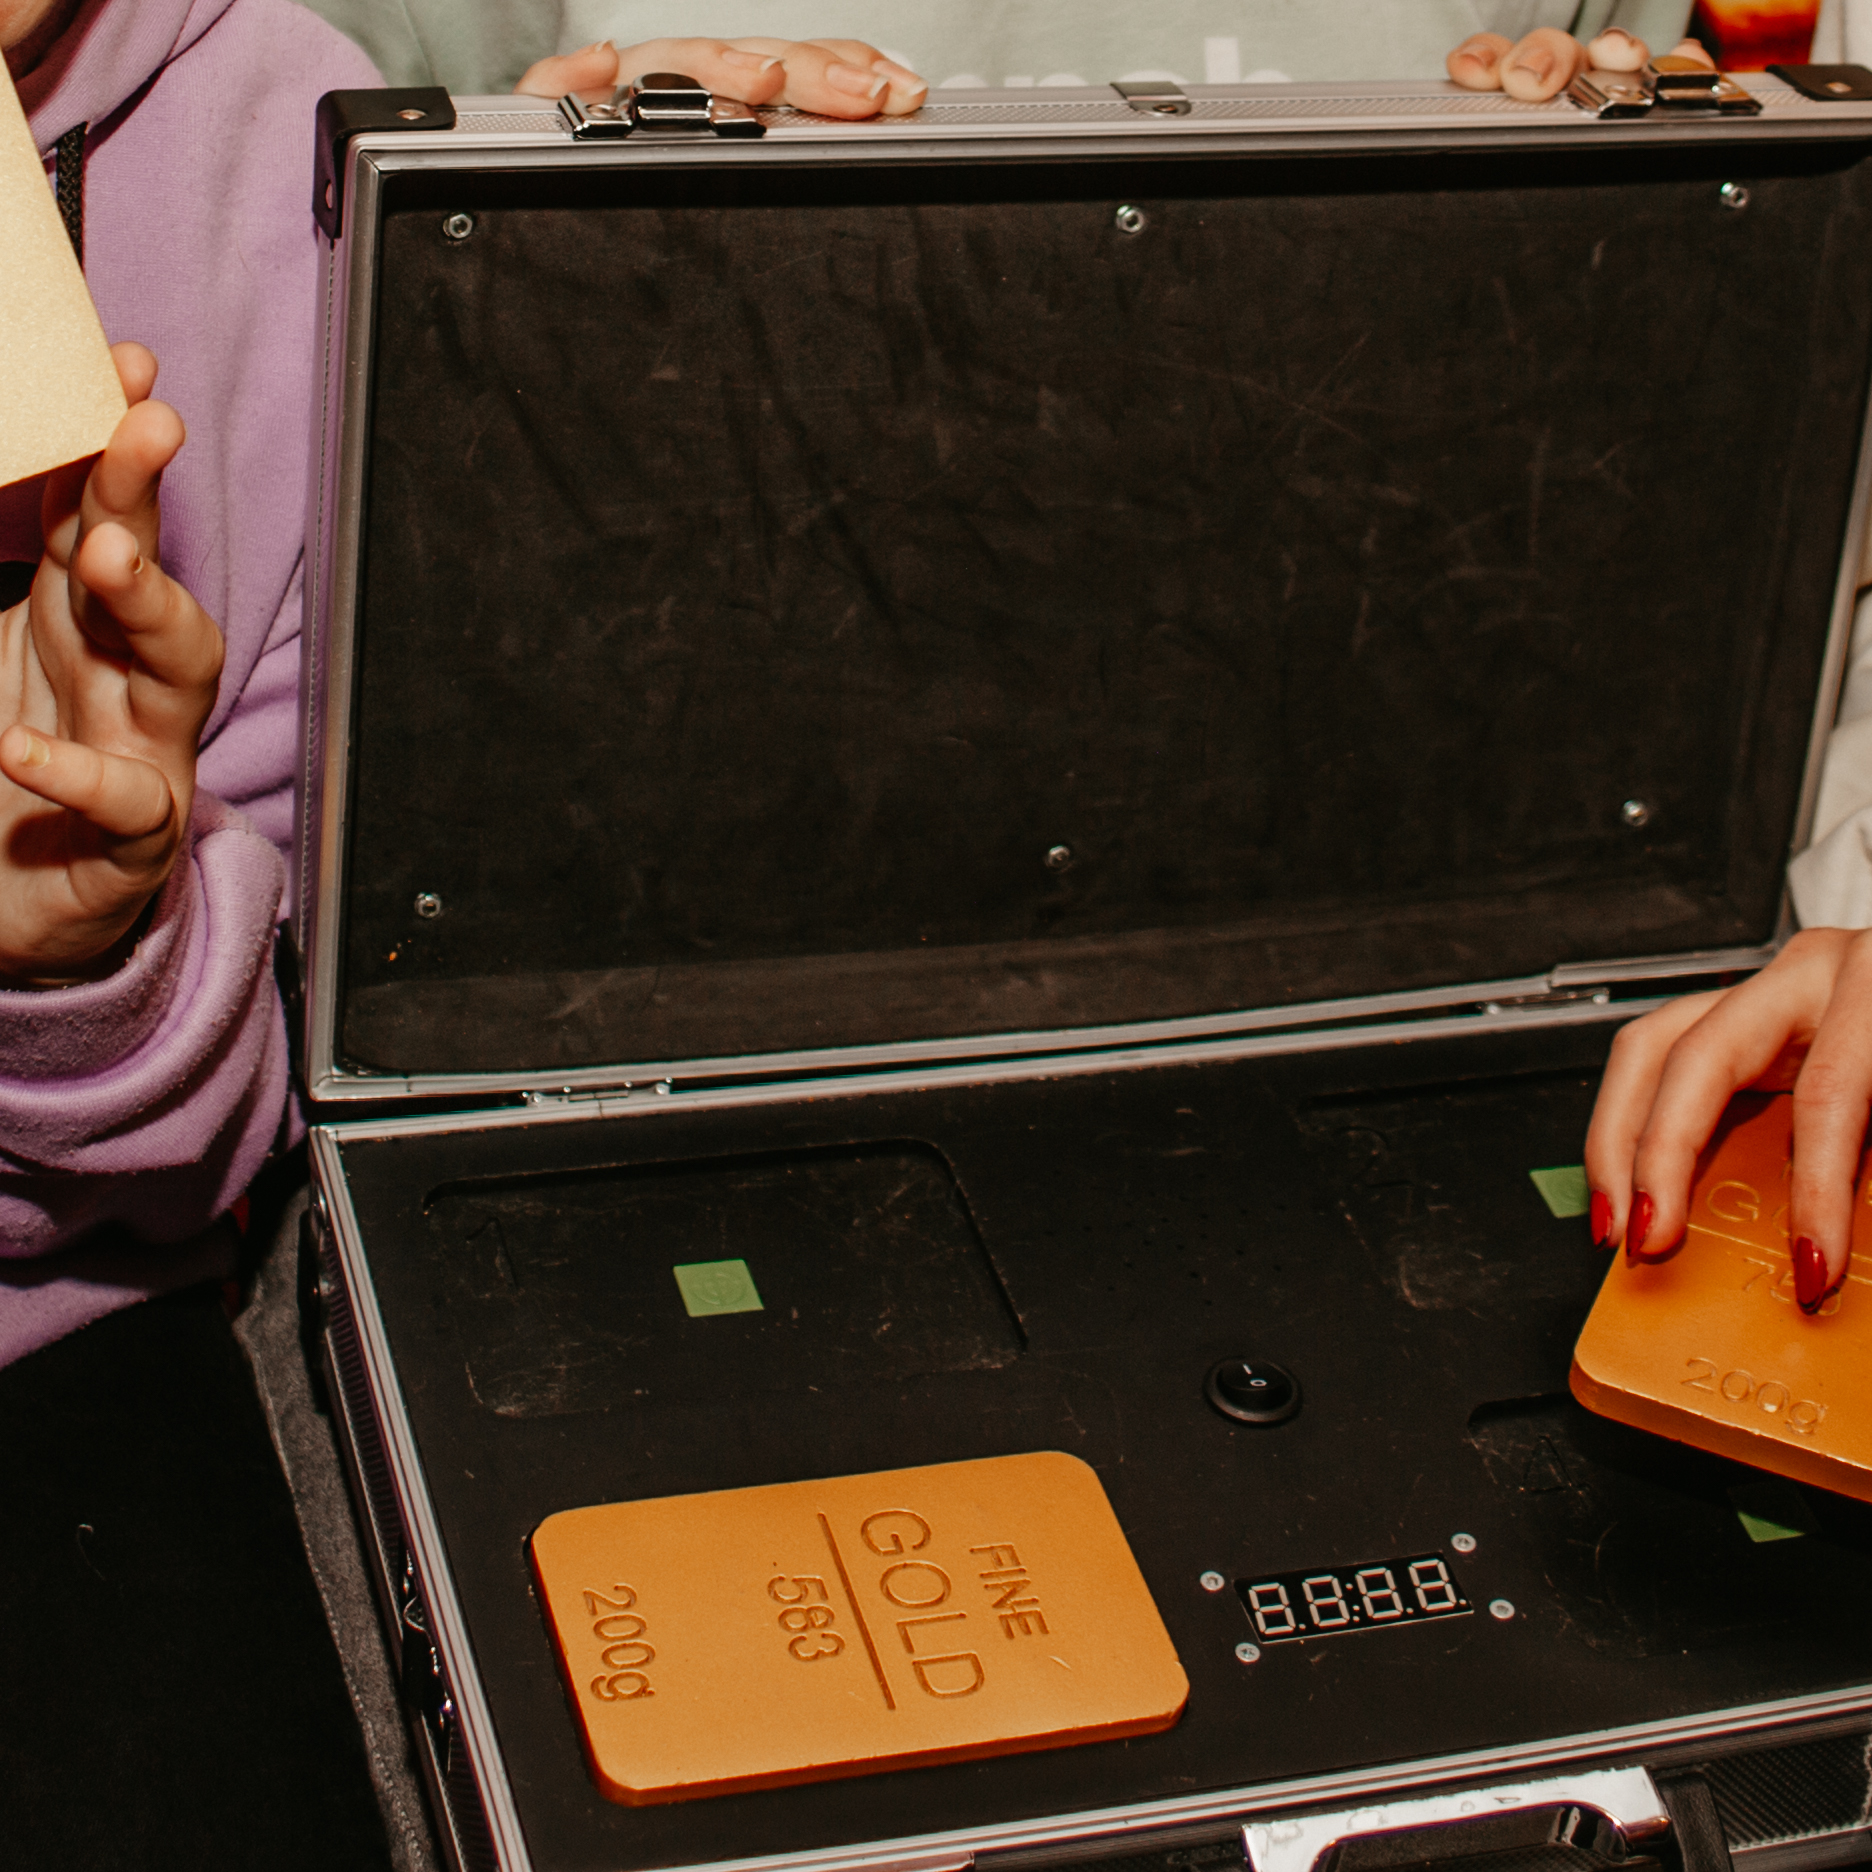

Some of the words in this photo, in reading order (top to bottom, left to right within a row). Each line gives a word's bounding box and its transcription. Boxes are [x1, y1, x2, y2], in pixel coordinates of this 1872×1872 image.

[1679, 1354, 1828, 1438] 200g
[766, 1573, 846, 1663] 583
[859, 1506, 987, 1700] GOLD
[967, 1540, 1051, 1641] FINE
[581, 1582, 658, 1703] 200g
